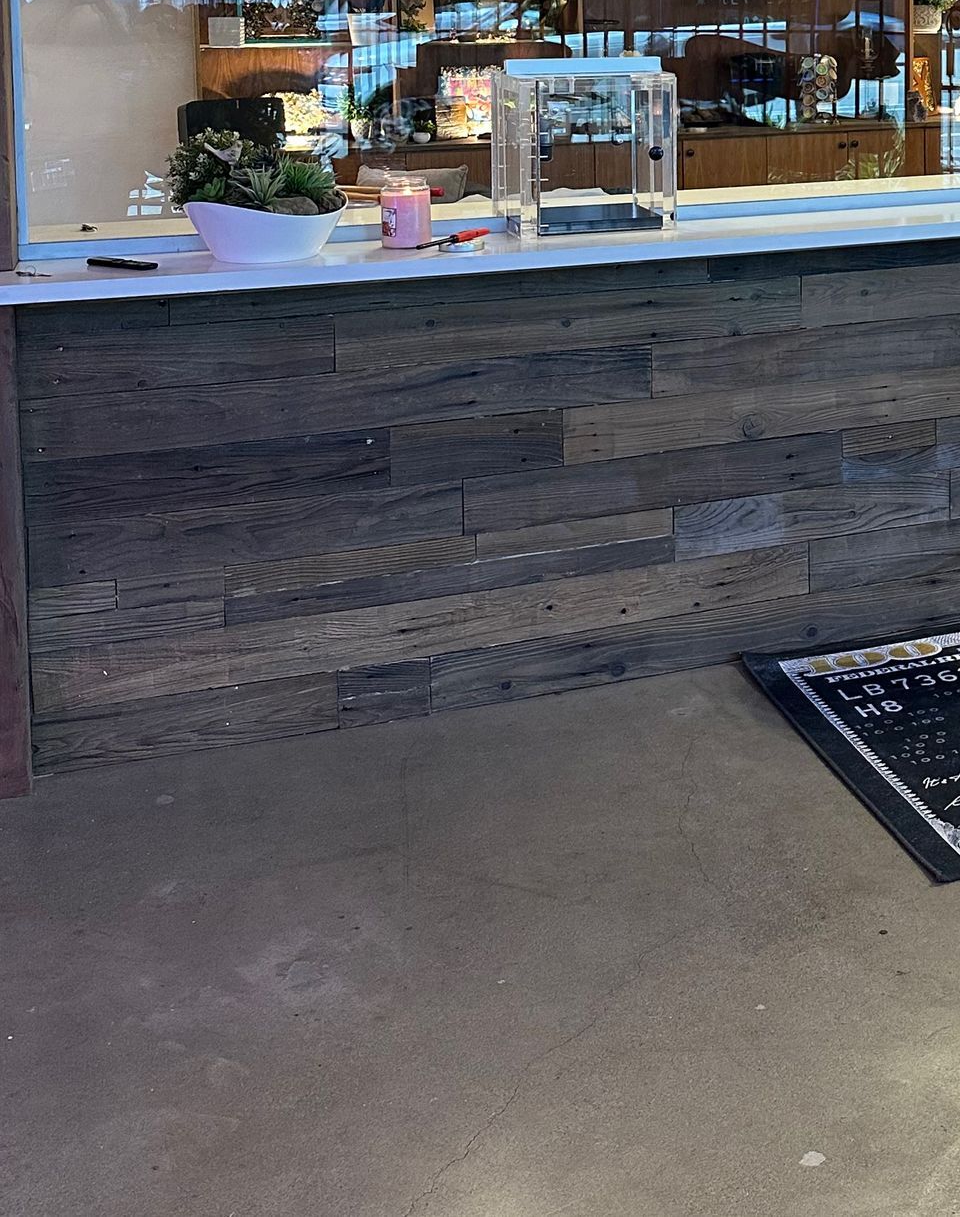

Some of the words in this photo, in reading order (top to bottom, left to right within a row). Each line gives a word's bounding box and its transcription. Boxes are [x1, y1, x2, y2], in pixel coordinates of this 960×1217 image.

[803, 641, 943, 677] 100
[824, 659, 937, 683] FEDERAL
[854, 699, 903, 717] H8
